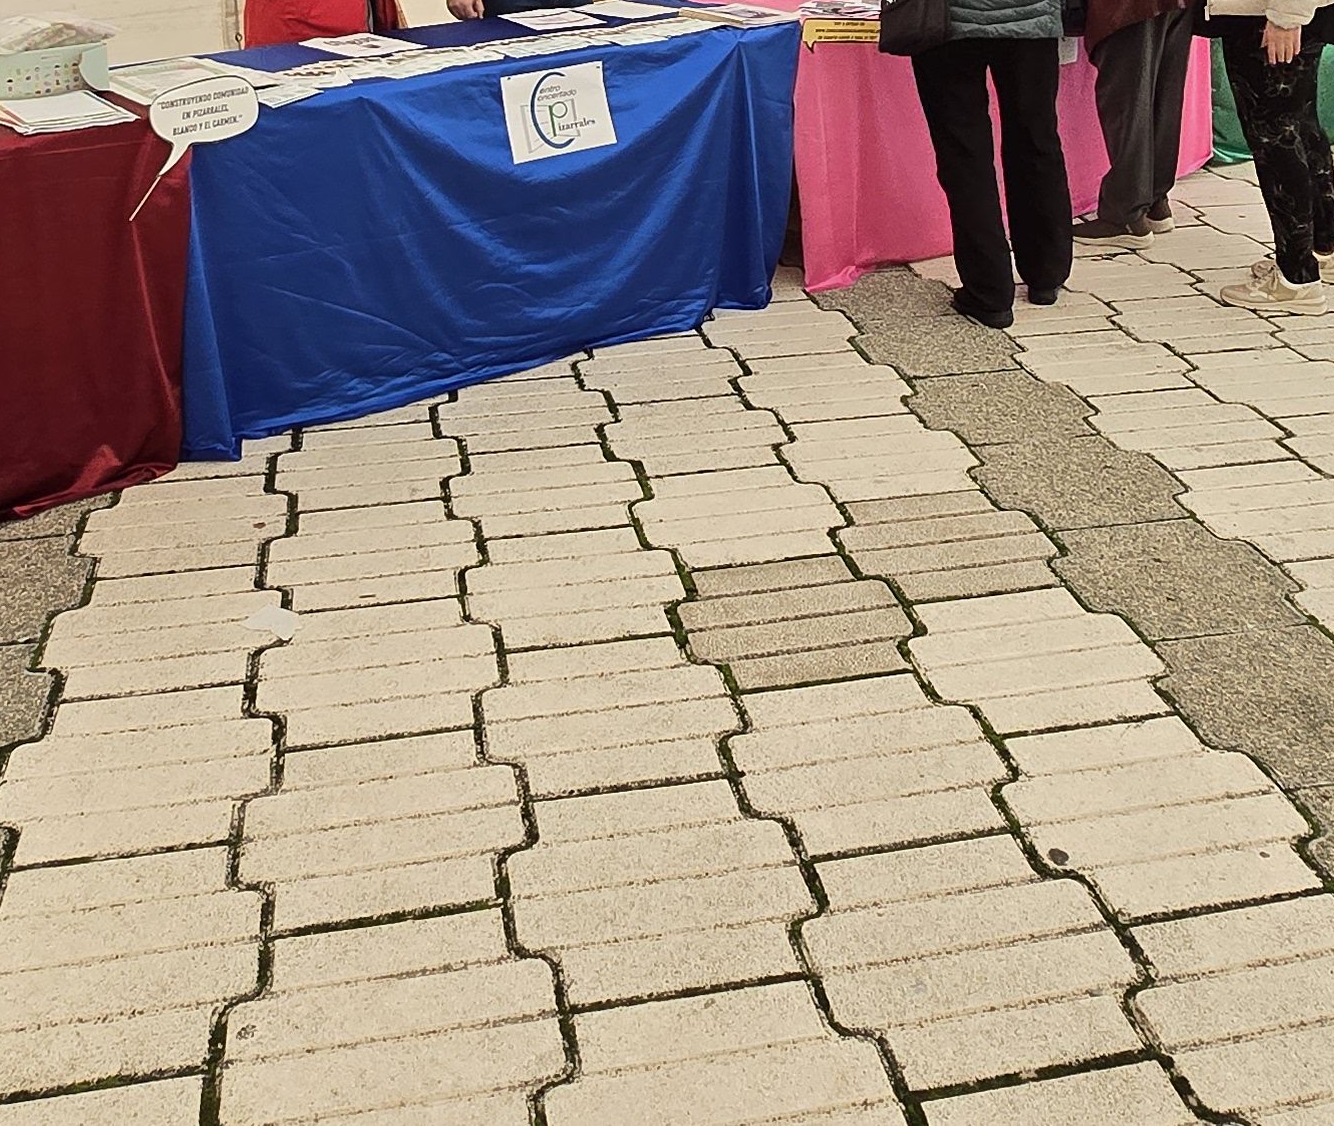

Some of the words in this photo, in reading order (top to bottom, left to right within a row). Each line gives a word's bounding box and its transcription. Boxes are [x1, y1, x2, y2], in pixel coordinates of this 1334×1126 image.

[213, 86, 249, 100] COMUNIDAD
[181, 110, 191, 121] EN
[173, 123, 198, 136] BLANCO
